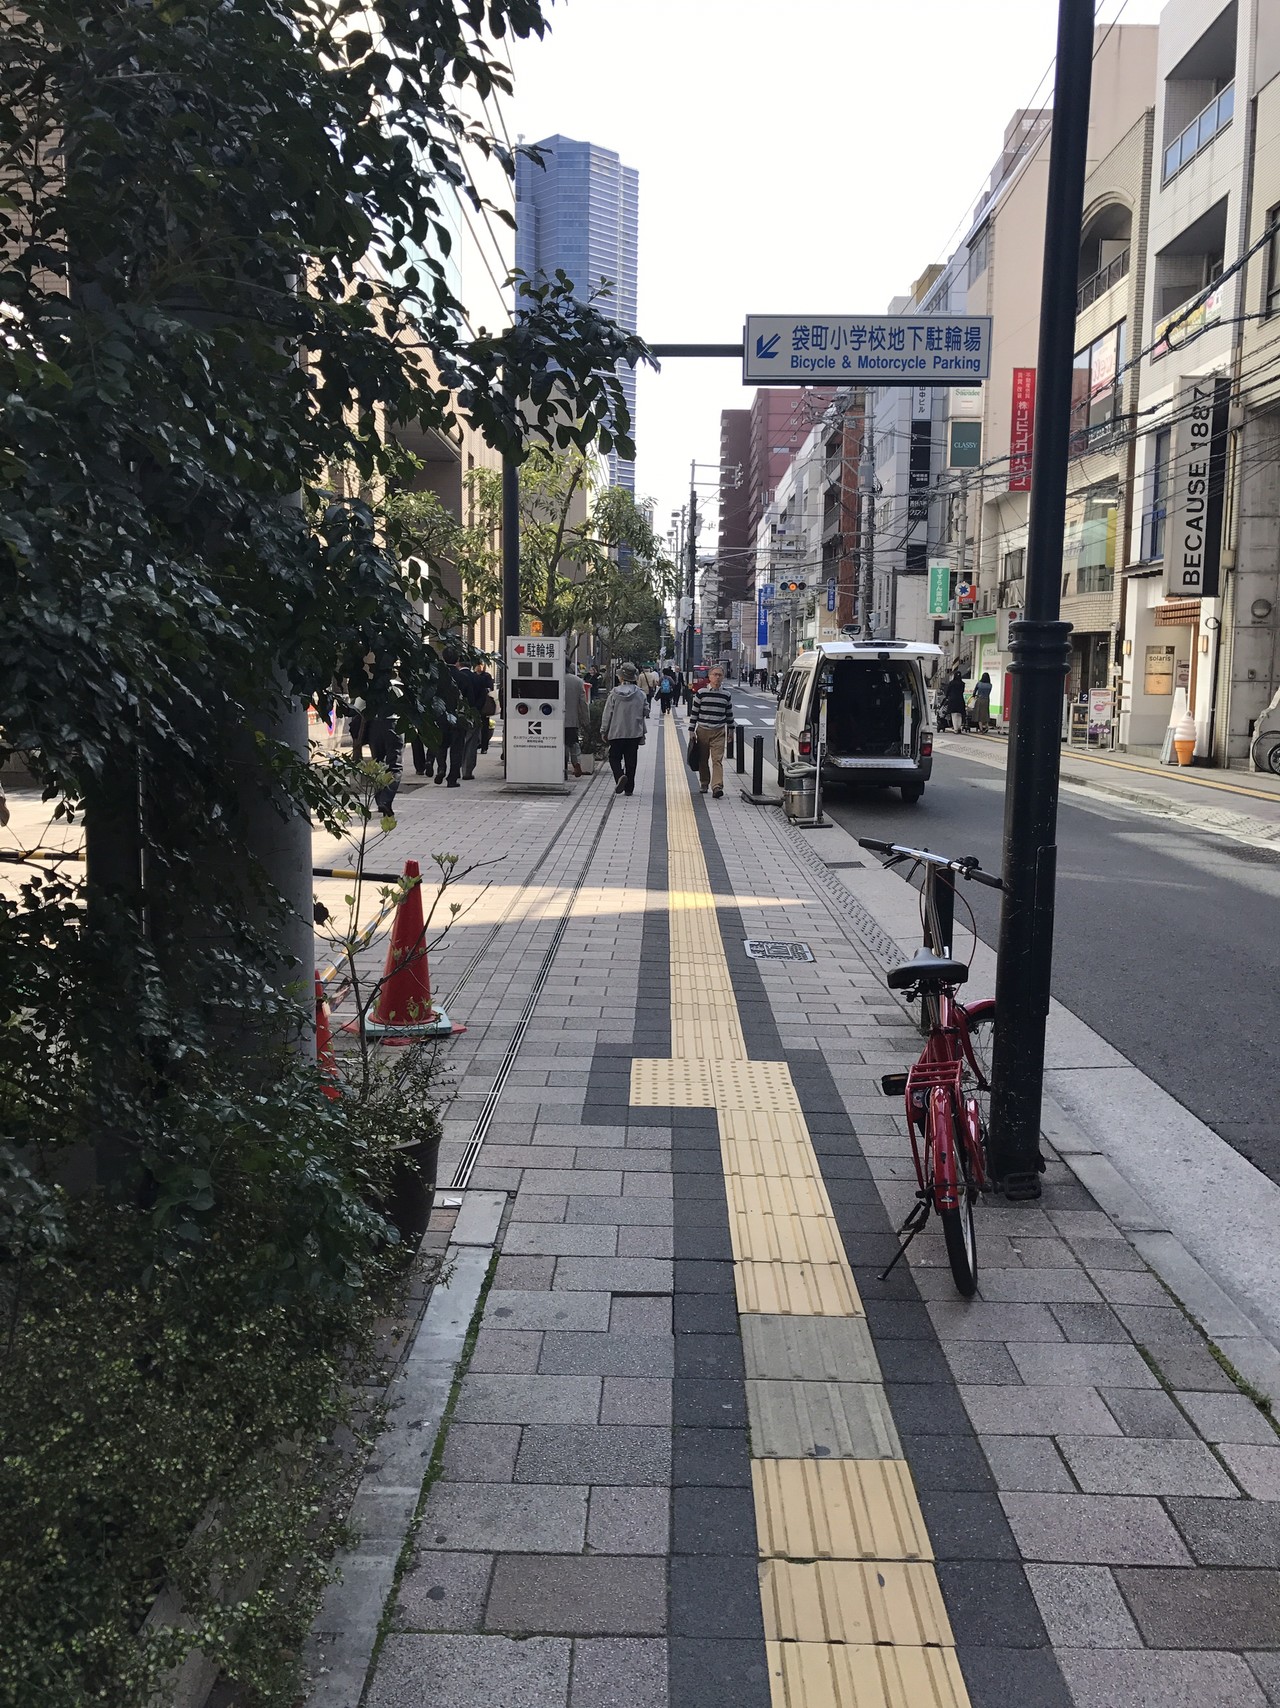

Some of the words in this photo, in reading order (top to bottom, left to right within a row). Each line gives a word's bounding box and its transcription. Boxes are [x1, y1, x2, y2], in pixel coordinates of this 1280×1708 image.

[791, 325, 982, 352] 袋町小学校地下駐輪場
[790, 355, 836, 371] Bicycle
[841, 355, 852, 369] &
[857, 355, 927, 371] Motorcycle
[932, 355, 981, 372] Parking
[1190, 386, 1211, 450] 1887
[953, 441, 978, 449] CLASSY
[1182, 462, 1207, 587] BECAUSE
[526, 643, 555, 658] 駐輪場
[1148, 654, 1171, 662] solaris
